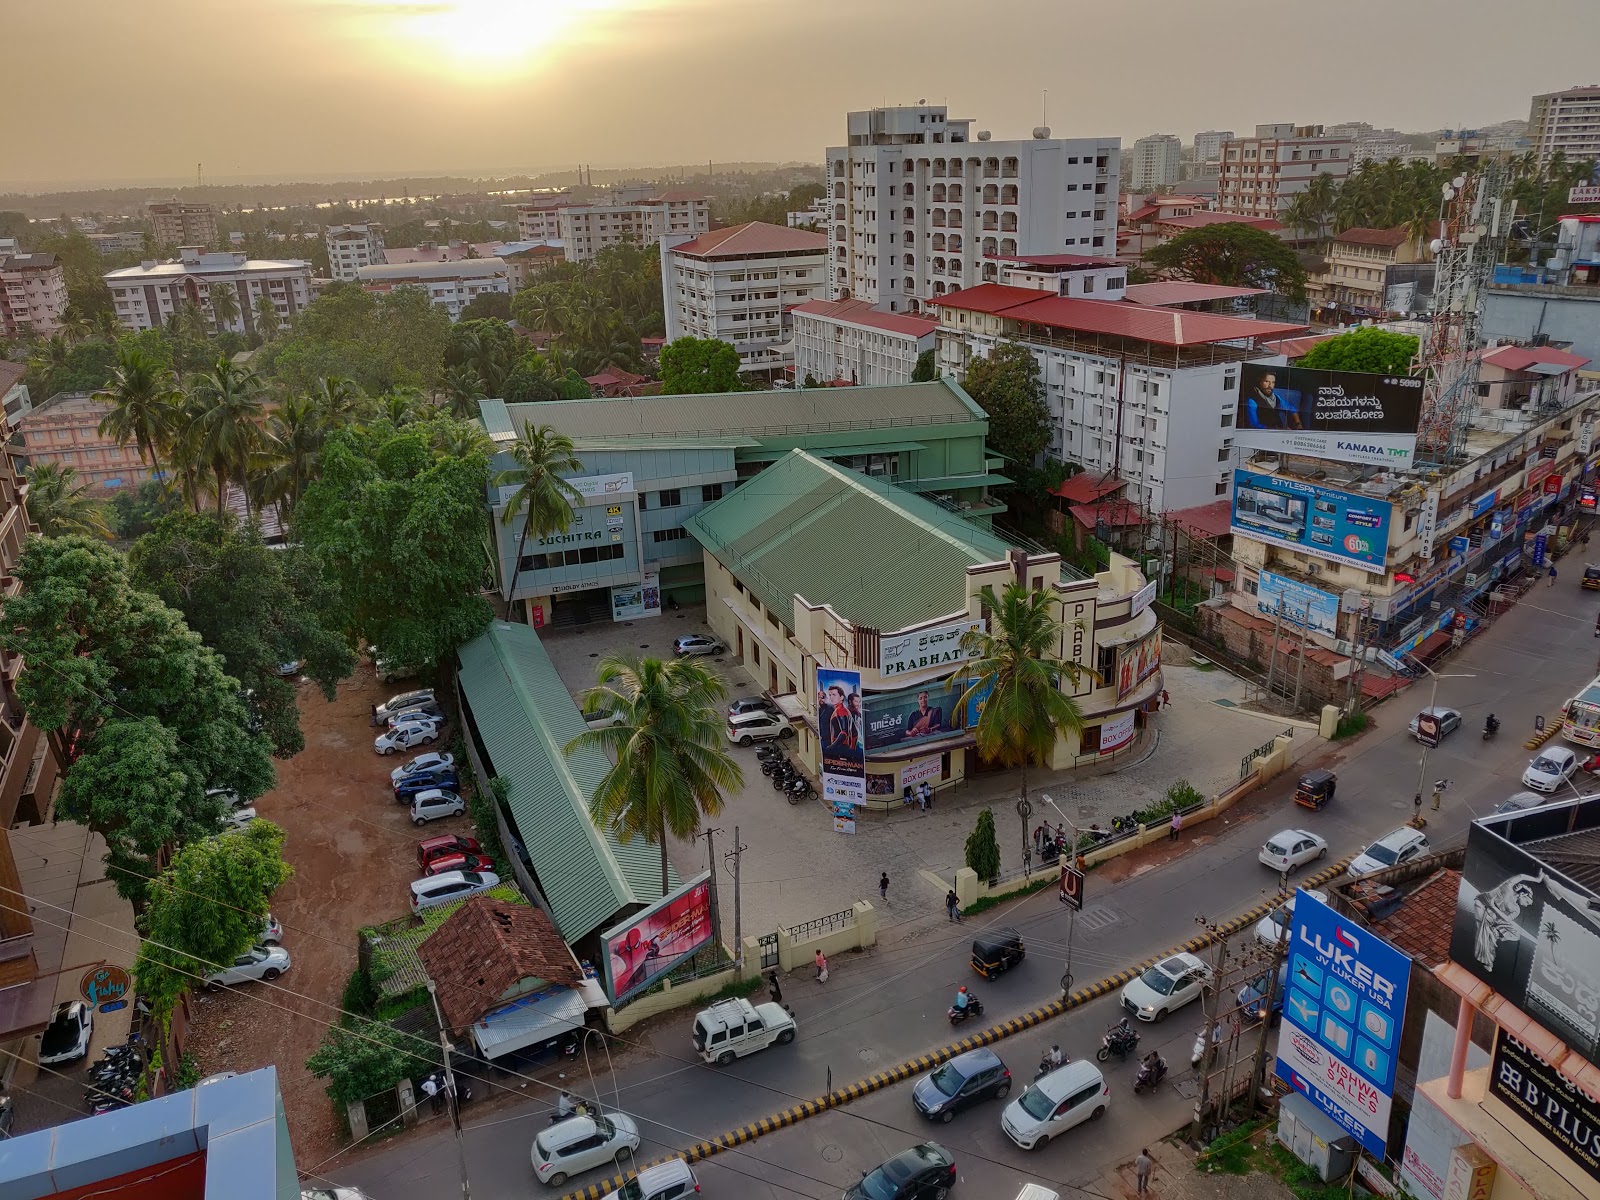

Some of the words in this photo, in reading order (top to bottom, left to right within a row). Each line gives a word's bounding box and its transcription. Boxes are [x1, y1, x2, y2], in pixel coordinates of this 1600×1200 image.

[1318, 385, 1345, 396] ನಾವು
[1316, 396, 1382, 410] ವಿಷಯಗಳನ್ನು
[1337, 442, 1384, 454] KANARA
[1387, 448, 1409, 457] TMT
[1271, 478, 1315, 494] STYLESPA
[608, 506, 619, 514] 4K
[538, 530, 602, 546] SUCHITRA
[918, 628, 960, 652] ಪ್ರಭಾತ್
[885, 649, 962, 675] PRABHAT
[1102, 734, 1117, 744] BOX
[824, 758, 863, 769] SPIDER-MAN
[902, 774, 917, 785] BOX
[918, 765, 941, 779] OFFICE
[1300, 923, 1394, 1001] LUKER
[1316, 954, 1329, 967] JV
[1331, 963, 1366, 993] LUKER
[1368, 988, 1392, 1011] USA
[1327, 1068, 1377, 1114] SALES
[1328, 1056, 1380, 1104] VISHWA
[1315, 1090, 1366, 1136] LUKER
[1524, 1079, 1600, 1158] B'PLUS
[1332, 1112, 1351, 1130] LUKER
[1351, 1127, 1364, 1141] USA
[1497, 1082, 1534, 1117] PROFESSIONAL
[1534, 1111, 1553, 1131] UNISEX
[1553, 1126, 1570, 1147] SALON
[1574, 1144, 1599, 1169] ACADEMY
